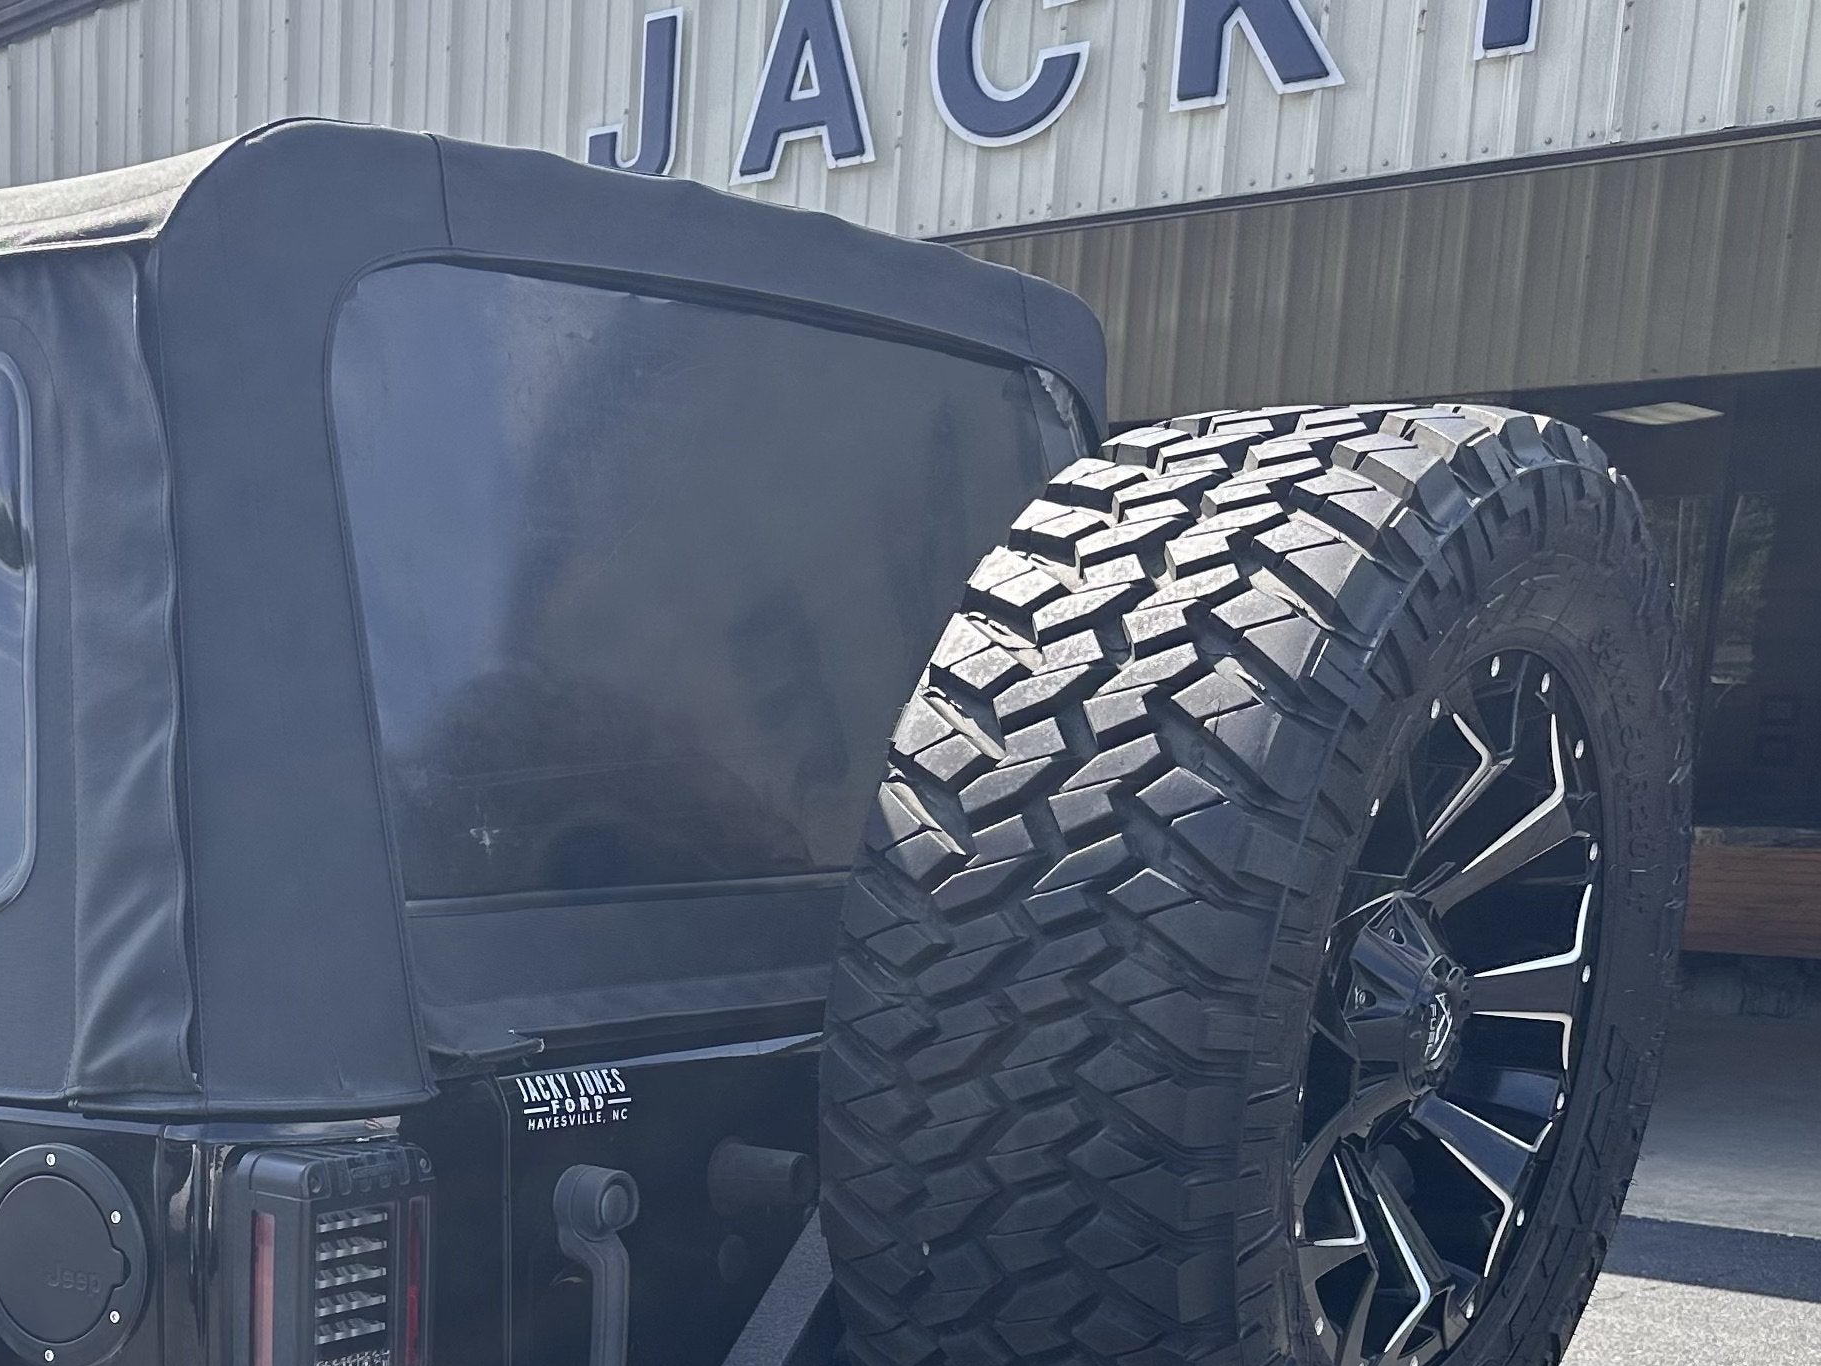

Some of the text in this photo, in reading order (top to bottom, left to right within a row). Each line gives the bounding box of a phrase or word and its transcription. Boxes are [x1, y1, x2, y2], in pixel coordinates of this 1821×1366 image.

[516, 1068, 626, 1102] JACKY JONES
[551, 1095, 605, 1114] FORD
[527, 1108, 628, 1131] HAYESVILLE, NC
[47, 1261, 101, 1297] Jeep
